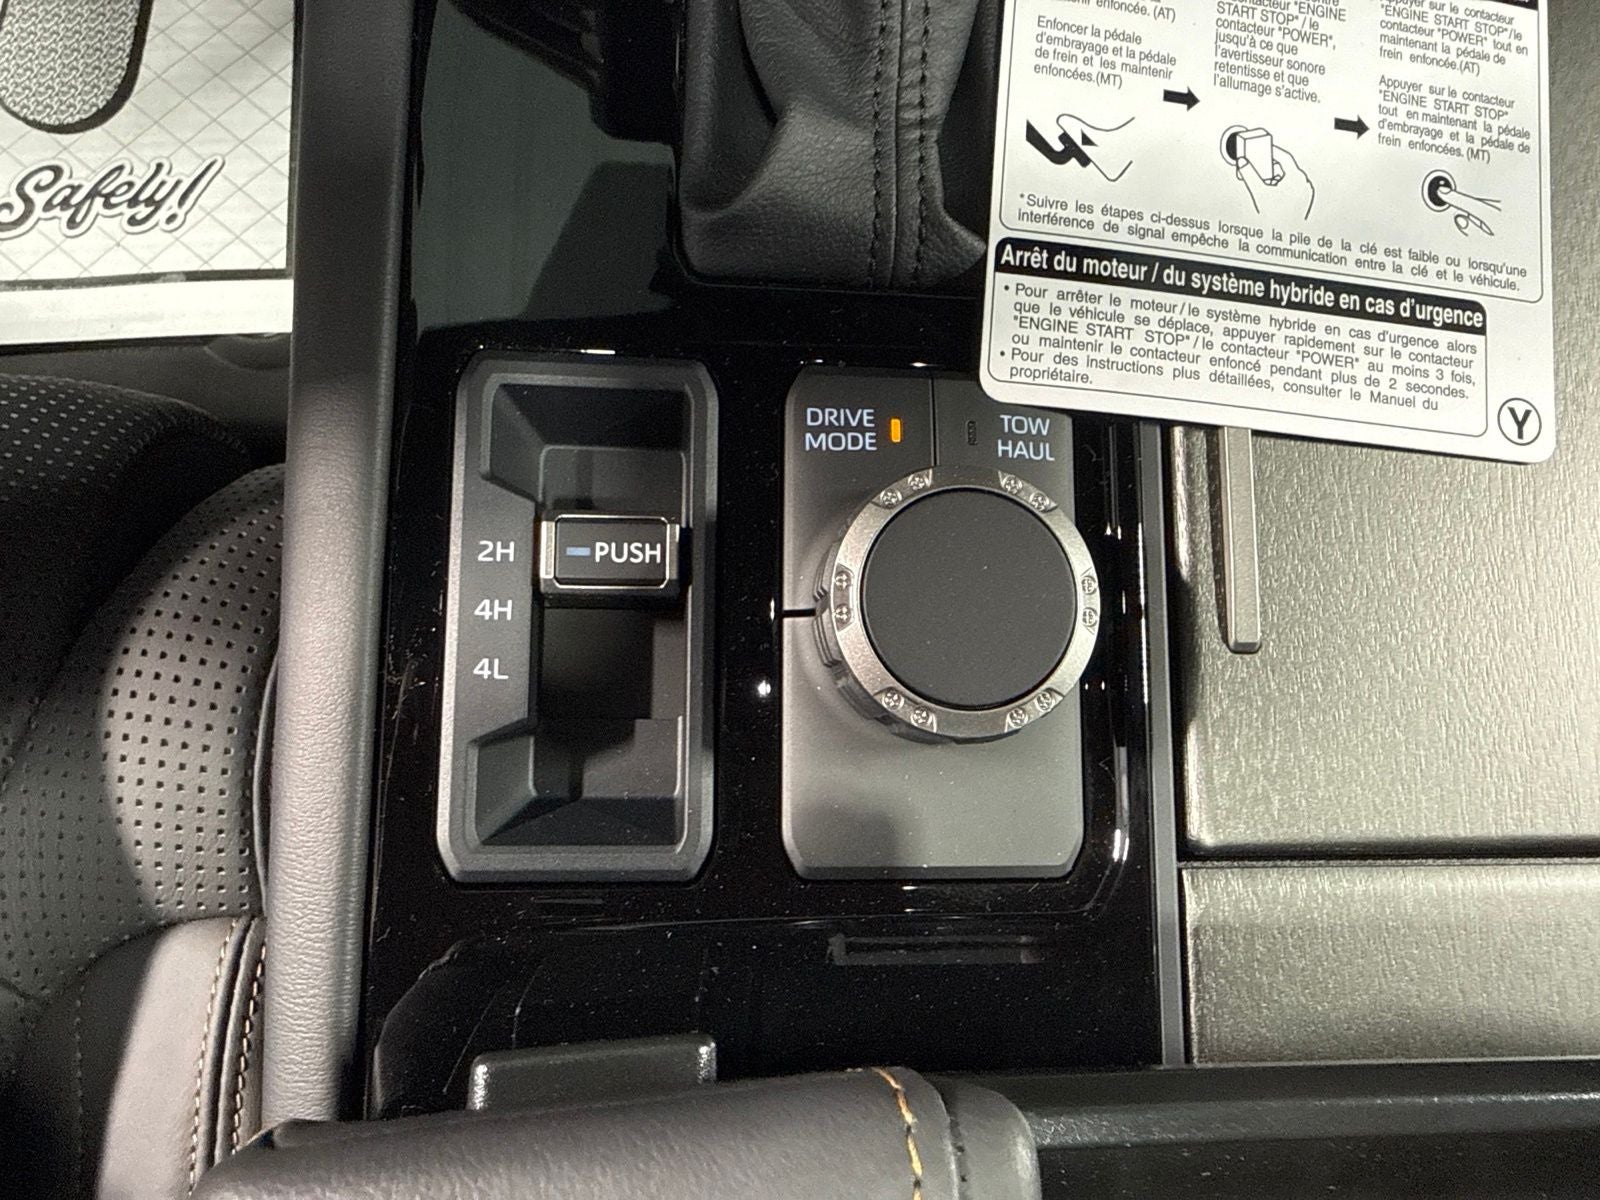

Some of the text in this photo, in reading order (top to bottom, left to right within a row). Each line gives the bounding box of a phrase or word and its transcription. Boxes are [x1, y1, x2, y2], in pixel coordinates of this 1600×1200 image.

[1215, 17, 1275, 38] contacteur
[1216, 1, 1257, 20] START
[1308, 17, 1319, 31] le
[1036, 15, 1142, 45] Enfoncer la pédale
[1111, 45, 1123, 57] et
[1125, 46, 1136, 60] la
[1138, 49, 1176, 66] pédale
[1259, 39, 1273, 51] ce
[1276, 42, 1298, 56] que
[1034, 45, 1173, 80] de frein et les maintenir
[1214, 60, 1309, 87] retentisse et que
[1286, 59, 1325, 75] sonore
[0, 157, 221, 234] Safely!
[1074, 199, 1094, 215] les
[1100, 203, 1144, 223] étapes
[1150, 211, 1210, 232] ci-dessus
[1218, 220, 1264, 241] lorsque
[1271, 228, 1283, 243] la
[1289, 231, 1311, 247] pile
[1316, 234, 1333, 250] de
[1340, 238, 1352, 253] la
[1359, 241, 1378, 256] clé
[1383, 246, 1402, 260] est
[1407, 248, 1439, 265] faible
[1445, 256, 1460, 268] ou
[1468, 256, 1527, 278] lorsqu'une
[1102, 219, 1119, 235] de
[1126, 223, 1165, 241] signal
[1170, 232, 1229, 250] empêche
[1238, 238, 1250, 253] la
[1255, 244, 1347, 267] communication
[1354, 257, 1386, 272] entre
[1392, 260, 1403, 275] la
[1410, 263, 1428, 278] clé
[1435, 268, 1447, 281] et
[1452, 269, 1464, 283] le
[1468, 272, 1520, 291] véhicule.
[1000, 245, 1048, 271] Arrêt
[1053, 252, 1076, 274] du
[1082, 260, 1148, 284] moteur
[1162, 266, 1186, 289] du
[1190, 275, 1265, 299] système
[1269, 281, 1334, 308] hybride
[1338, 294, 1360, 311] en
[1364, 298, 1395, 316] cas
[1399, 298, 1482, 328] d'urgence
[1014, 282, 1477, 355] Pour arrêter le système hybride en cas d'urgence alors
[1013, 300, 1474, 369] que le véhicule se déplace, appuyer rapidement sur le contacteur
[1011, 333, 1468, 399] ou maintenir le contacteur enfoncé pendant plus de 2 secondes.
[1085, 323, 1134, 342] START
[1202, 338, 1214, 352] le
[1220, 343, 1290, 362] contacteur
[1367, 361, 1383, 373] au
[1392, 363, 1430, 379] moins
[1435, 367, 1444, 381] 3
[1450, 368, 1475, 386] fois,
[1009, 366, 1092, 384] propriétaire.
[1010, 346, 1044, 364] Pour
[1052, 352, 1078, 368] des
[1172, 367, 1200, 383] plus
[1208, 370, 1274, 393] détaillées,
[1282, 382, 1342, 399] consulter
[1350, 387, 1361, 402] le
[1369, 390, 1416, 408] Manuel
[1422, 396, 1438, 411] du
[806, 407, 875, 427] DRIVE
[1000, 414, 1050, 436] TOW
[1507, 406, 1532, 440] Y
[805, 432, 877, 451] MODE
[998, 439, 1055, 461] HAUL
[477, 540, 515, 562] 2H
[595, 541, 661, 563] PUSH
[474, 599, 513, 621] 4H
[473, 658, 509, 680] 4L
